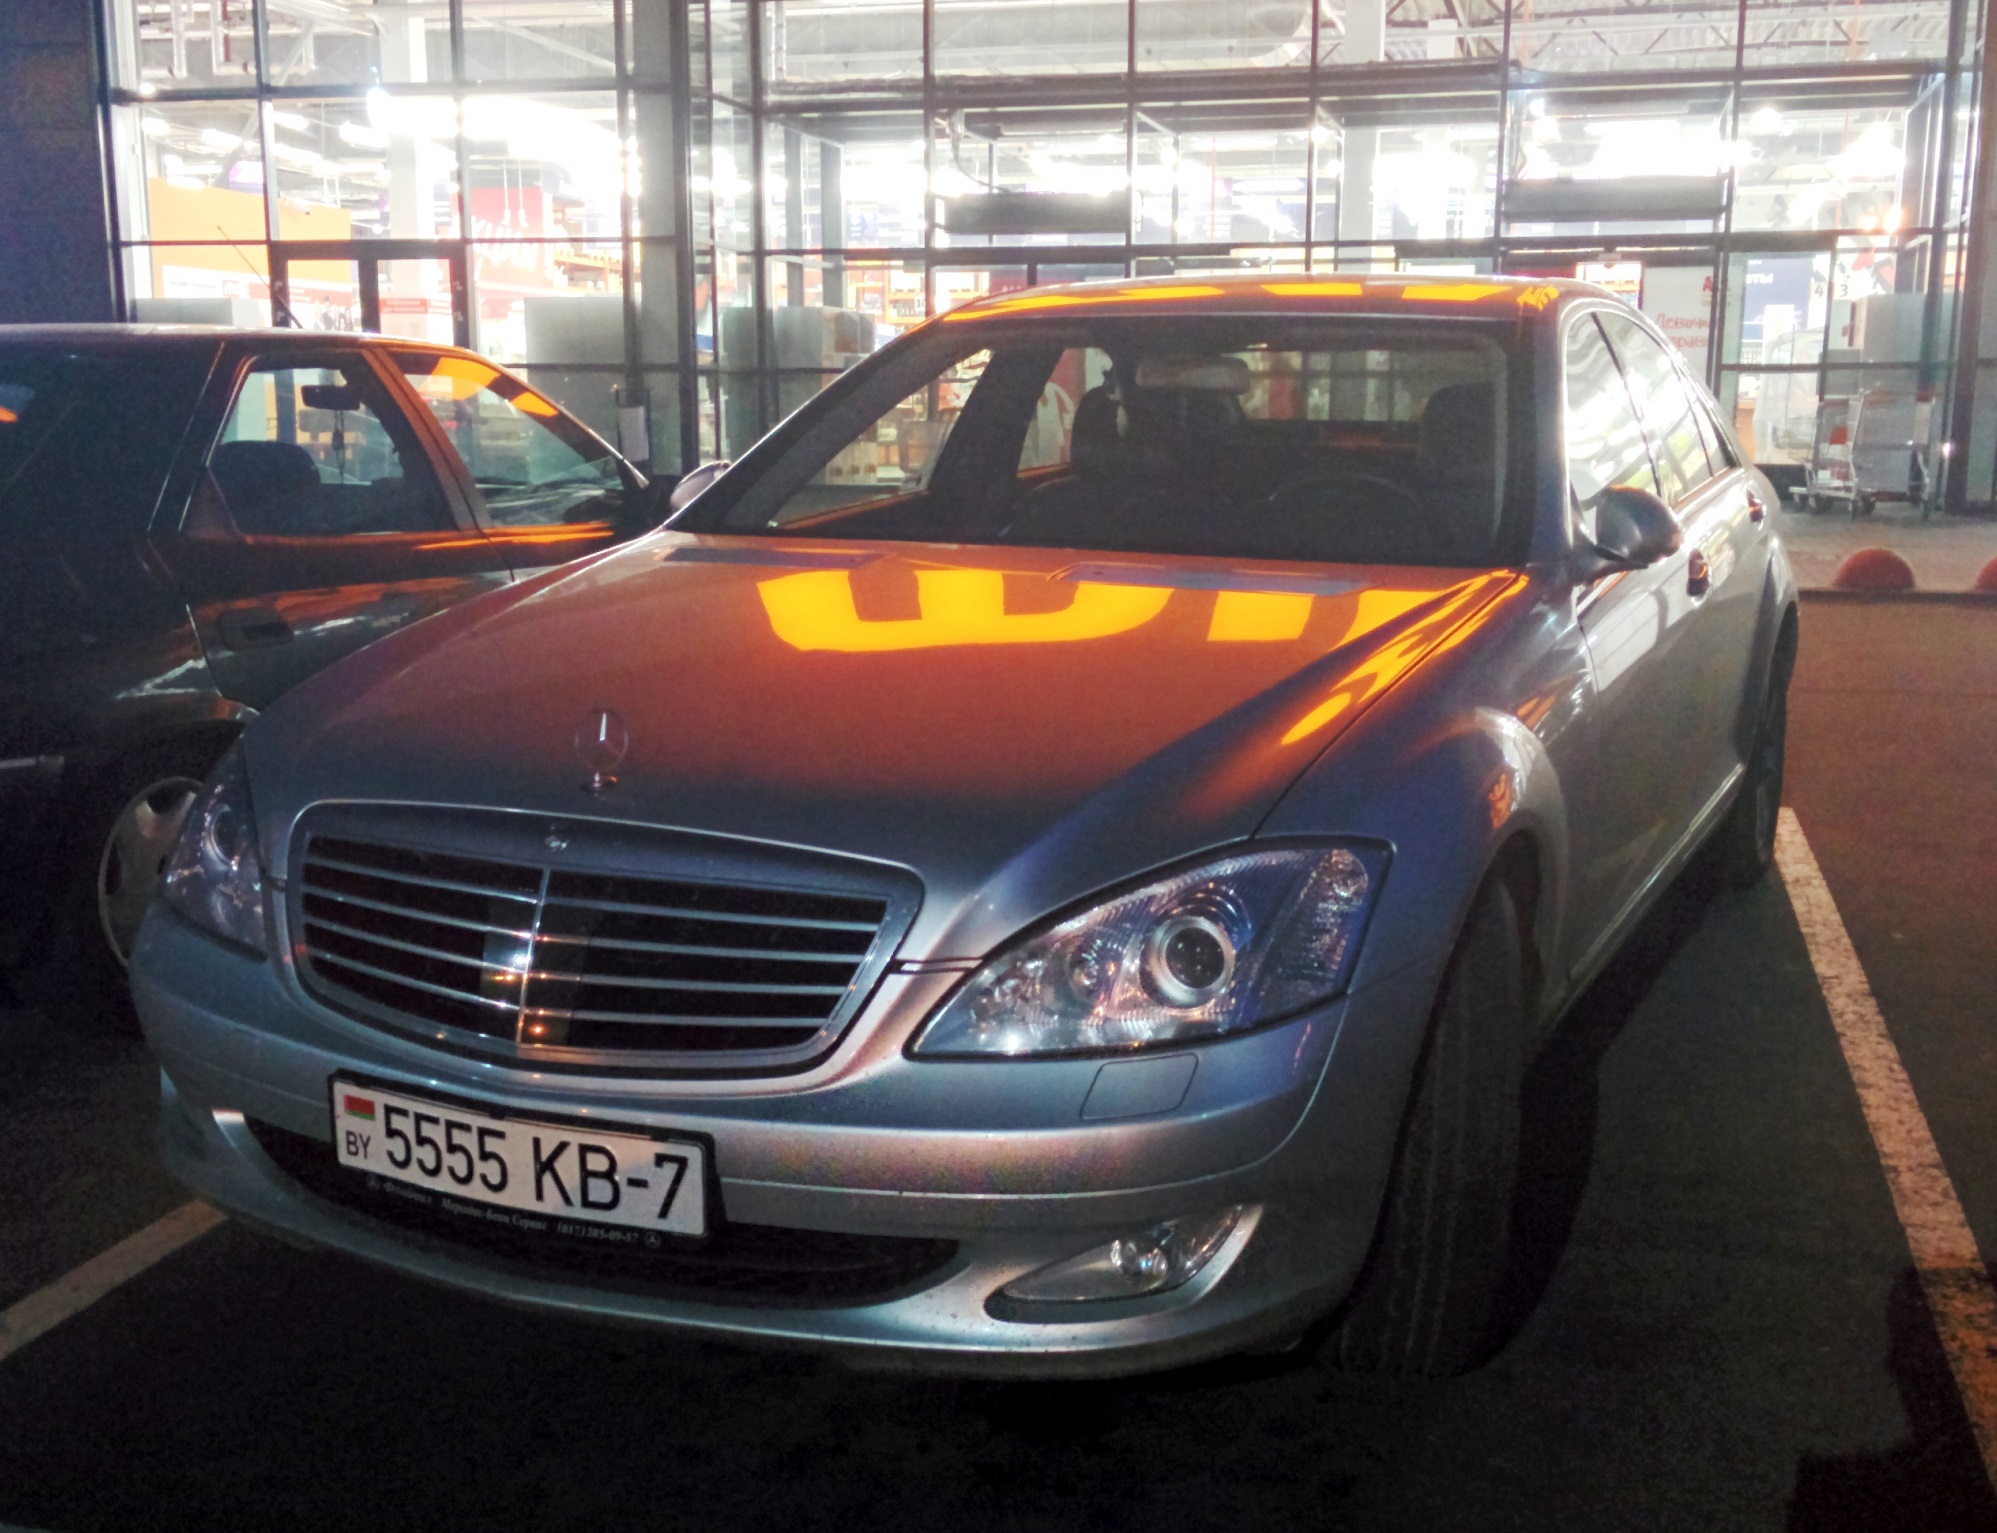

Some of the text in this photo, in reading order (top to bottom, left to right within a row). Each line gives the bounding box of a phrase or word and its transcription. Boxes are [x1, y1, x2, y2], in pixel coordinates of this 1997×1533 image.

[1814, 283, 1824, 297] 4
[1839, 284, 1849, 297] 3
[345, 1131, 371, 1160] BY
[383, 1103, 689, 1220] 5555 KB-7
